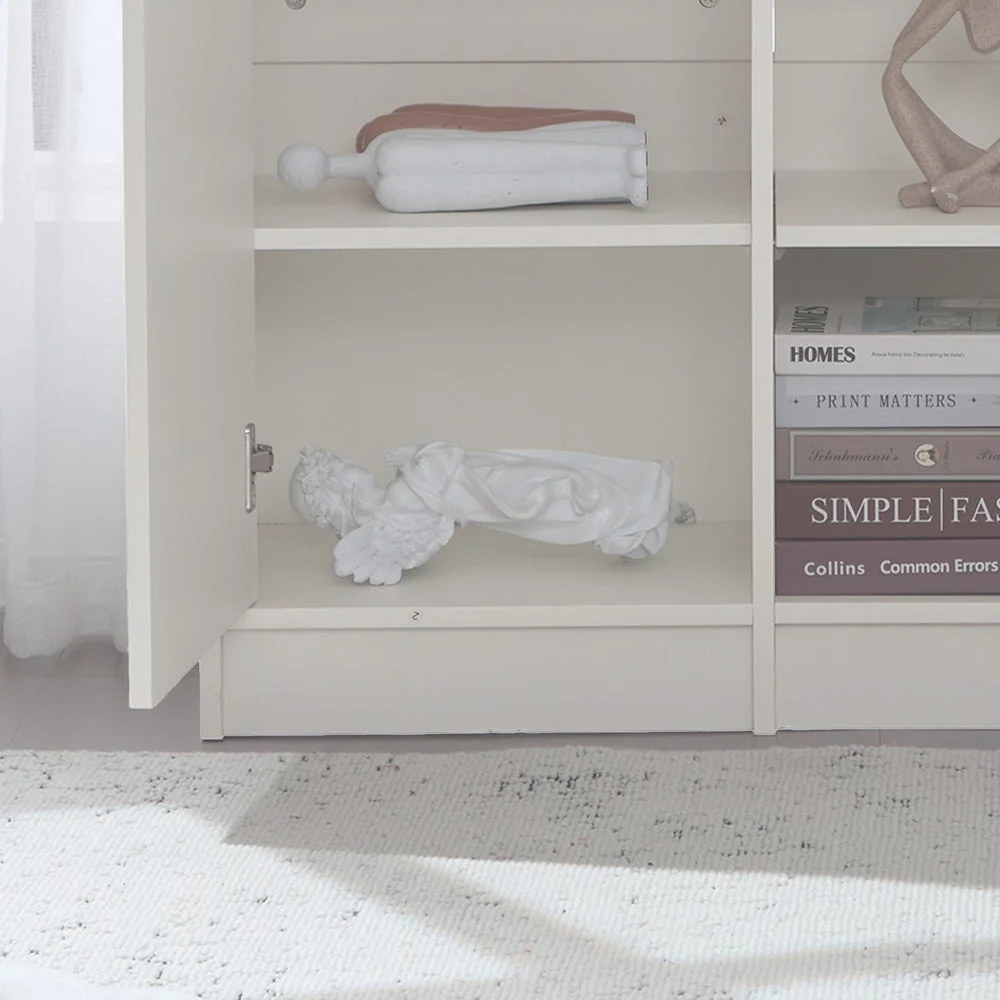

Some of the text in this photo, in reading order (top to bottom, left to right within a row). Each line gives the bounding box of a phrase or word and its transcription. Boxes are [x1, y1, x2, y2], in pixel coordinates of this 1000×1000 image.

[790, 346, 856, 363] HOMES
[816, 393, 957, 408] PRINT MATTERS
[811, 497, 933, 524] SIMPLE
[804, 561, 865, 576] Collins
[880, 559, 949, 575] Common
[954, 558, 999, 573] Errors
